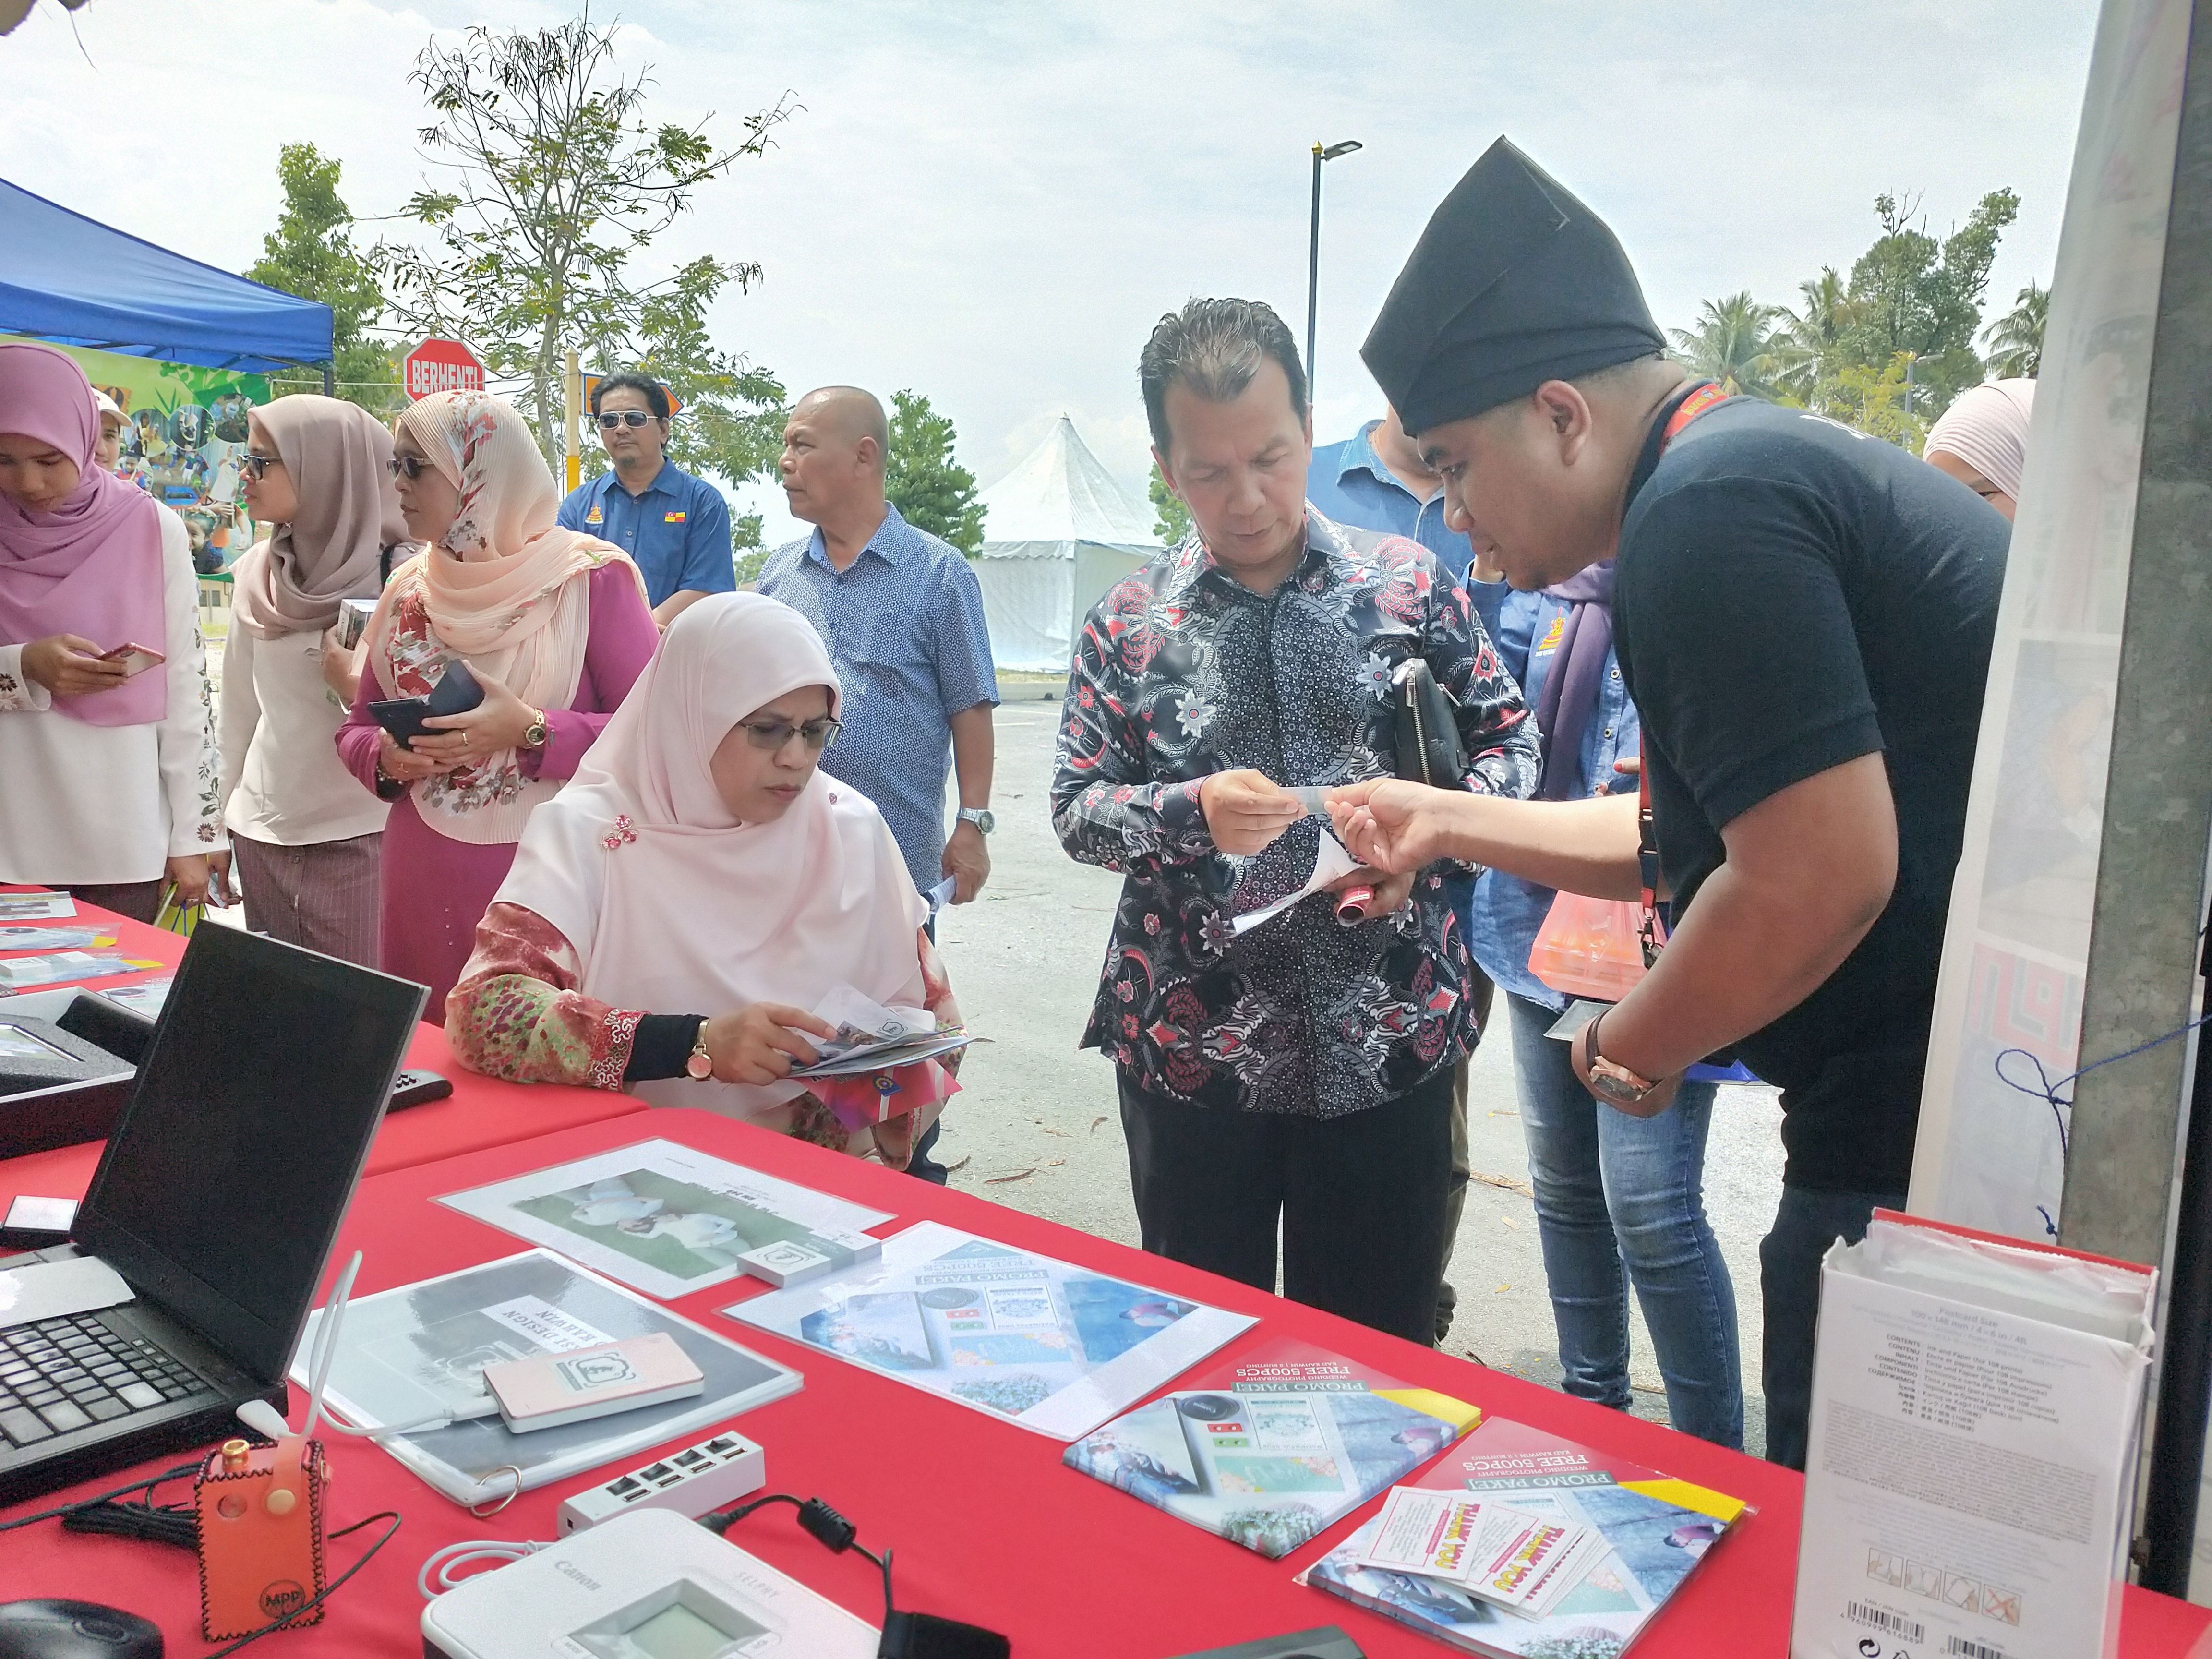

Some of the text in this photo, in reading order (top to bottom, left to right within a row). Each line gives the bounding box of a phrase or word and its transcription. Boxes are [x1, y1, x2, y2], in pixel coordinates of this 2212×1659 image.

[412, 359, 478, 394] BERHENTI
[977, 1272, 1044, 1281] PROMO
[502, 1310, 558, 1339] DESIGN
[1935, 1315, 1949, 1325] 148
[1951, 1321, 1968, 1330] mm
[1939, 1306, 1999, 1328] Postcard Size
[1887, 1334, 1920, 1347] CONTENTS
[1953, 1351, 1971, 1361] Paper
[1888, 1342, 1920, 1355] CONTENU
[1926, 1352, 1943, 1361] Encre
[1875, 1354, 1918, 1370] COMPONENTI
[1895, 1352, 1918, 1362] INHALT
[1236, 1366, 1351, 1377] FREE 500PCS
[1879, 1363, 1917, 1377] CONTENIDO
[1236, 1382, 1364, 1392] PROMO PAKEJ
[1463, 1455, 1588, 1471] FREE 500PCS
[1478, 1465, 1588, 1477] WEDDING PHOTOGRAPHY
[1469, 1473, 1611, 1490] PROMO PAKEJ
[1445, 1503, 1480, 1542] THANK
[1514, 1525, 1565, 1566] THANK
[1435, 1543, 1466, 1569] YOU
[555, 1560, 780, 1598] Canon SELPHY
[1493, 1563, 1532, 1593] YOU
[265, 1590, 300, 1606] MPP
